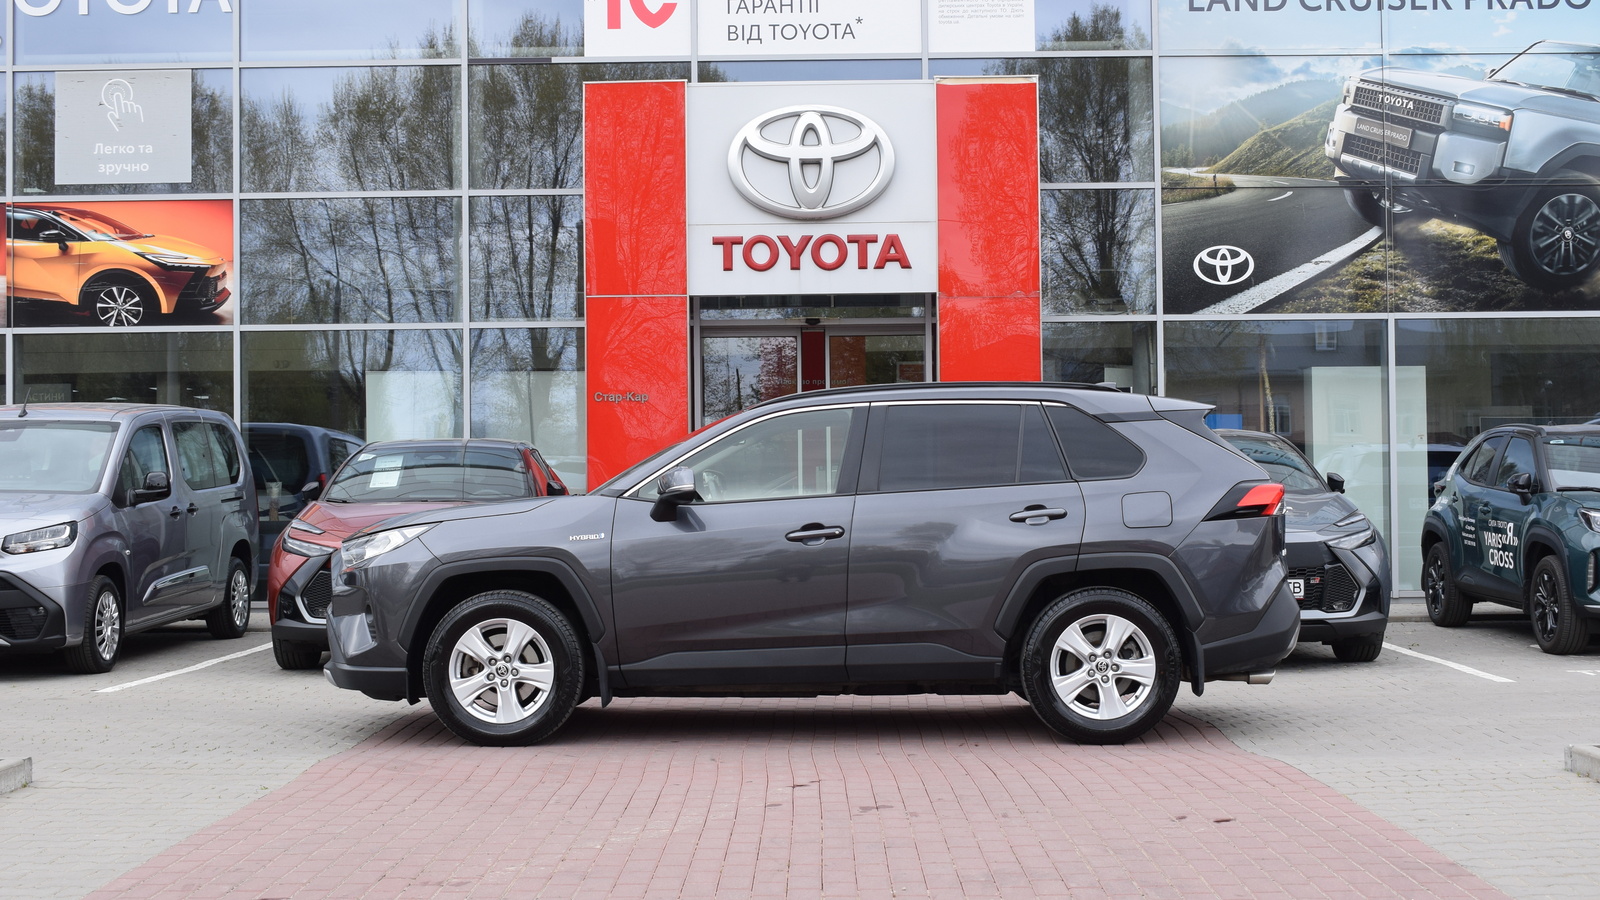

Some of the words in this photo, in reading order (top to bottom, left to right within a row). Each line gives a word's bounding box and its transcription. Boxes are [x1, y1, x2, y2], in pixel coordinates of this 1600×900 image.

[727, 24, 763, 44] ВІД
[1379, 94, 1414, 110] TOYOTA
[1356, 123, 1370, 132] LAND
[1370, 126, 1391, 136] CRUISER
[1390, 131, 1408, 142] PRADO
[93, 143, 135, 154] Легко
[138, 144, 153, 153] та
[98, 163, 149, 175] зручно
[712, 233, 912, 272] TOYOTA
[594, 392, 649, 404] Стар-Кар
[569, 533, 600, 541] HYBRID
[1483, 531, 1503, 548] YARIS
[1488, 548, 1515, 570] CROSS
[1289, 581, 1302, 595] B
